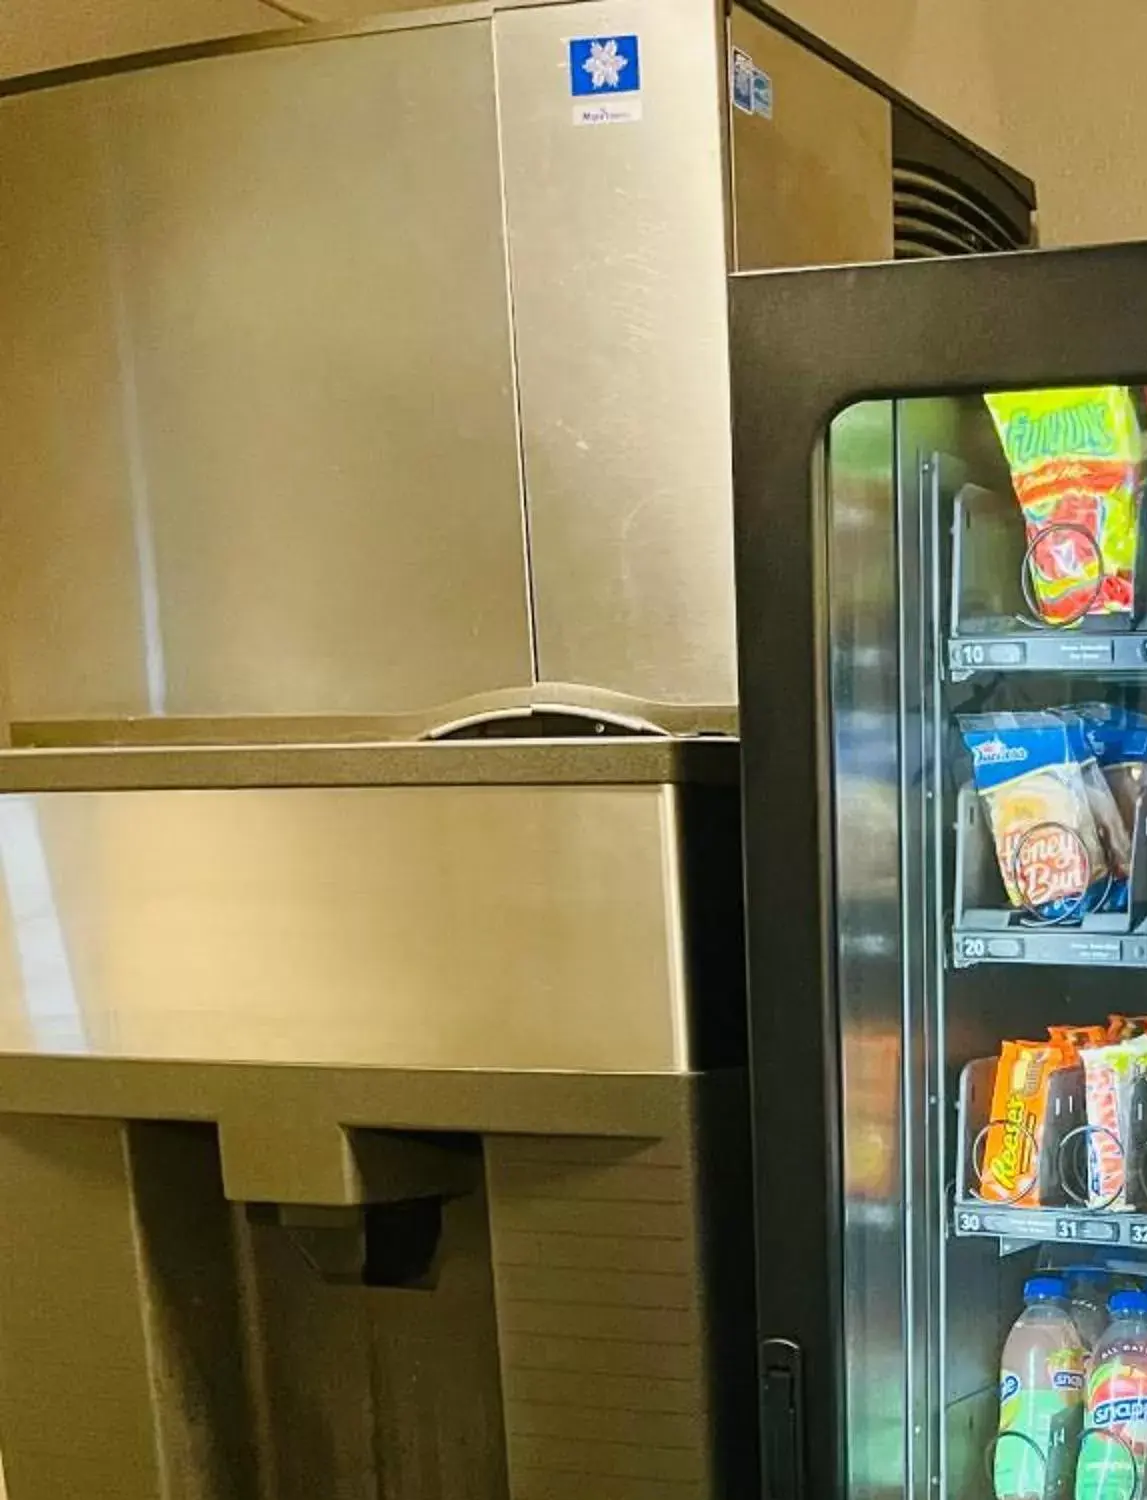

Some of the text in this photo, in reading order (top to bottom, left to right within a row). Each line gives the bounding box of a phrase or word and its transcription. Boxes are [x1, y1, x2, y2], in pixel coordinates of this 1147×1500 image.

[962, 645, 984, 662] 10
[1001, 828, 1083, 874] Honey
[1021, 862, 1083, 906] Bun
[964, 939, 984, 957] 20
[961, 1215, 980, 1231] 30
[1058, 1221, 1077, 1237] 31
